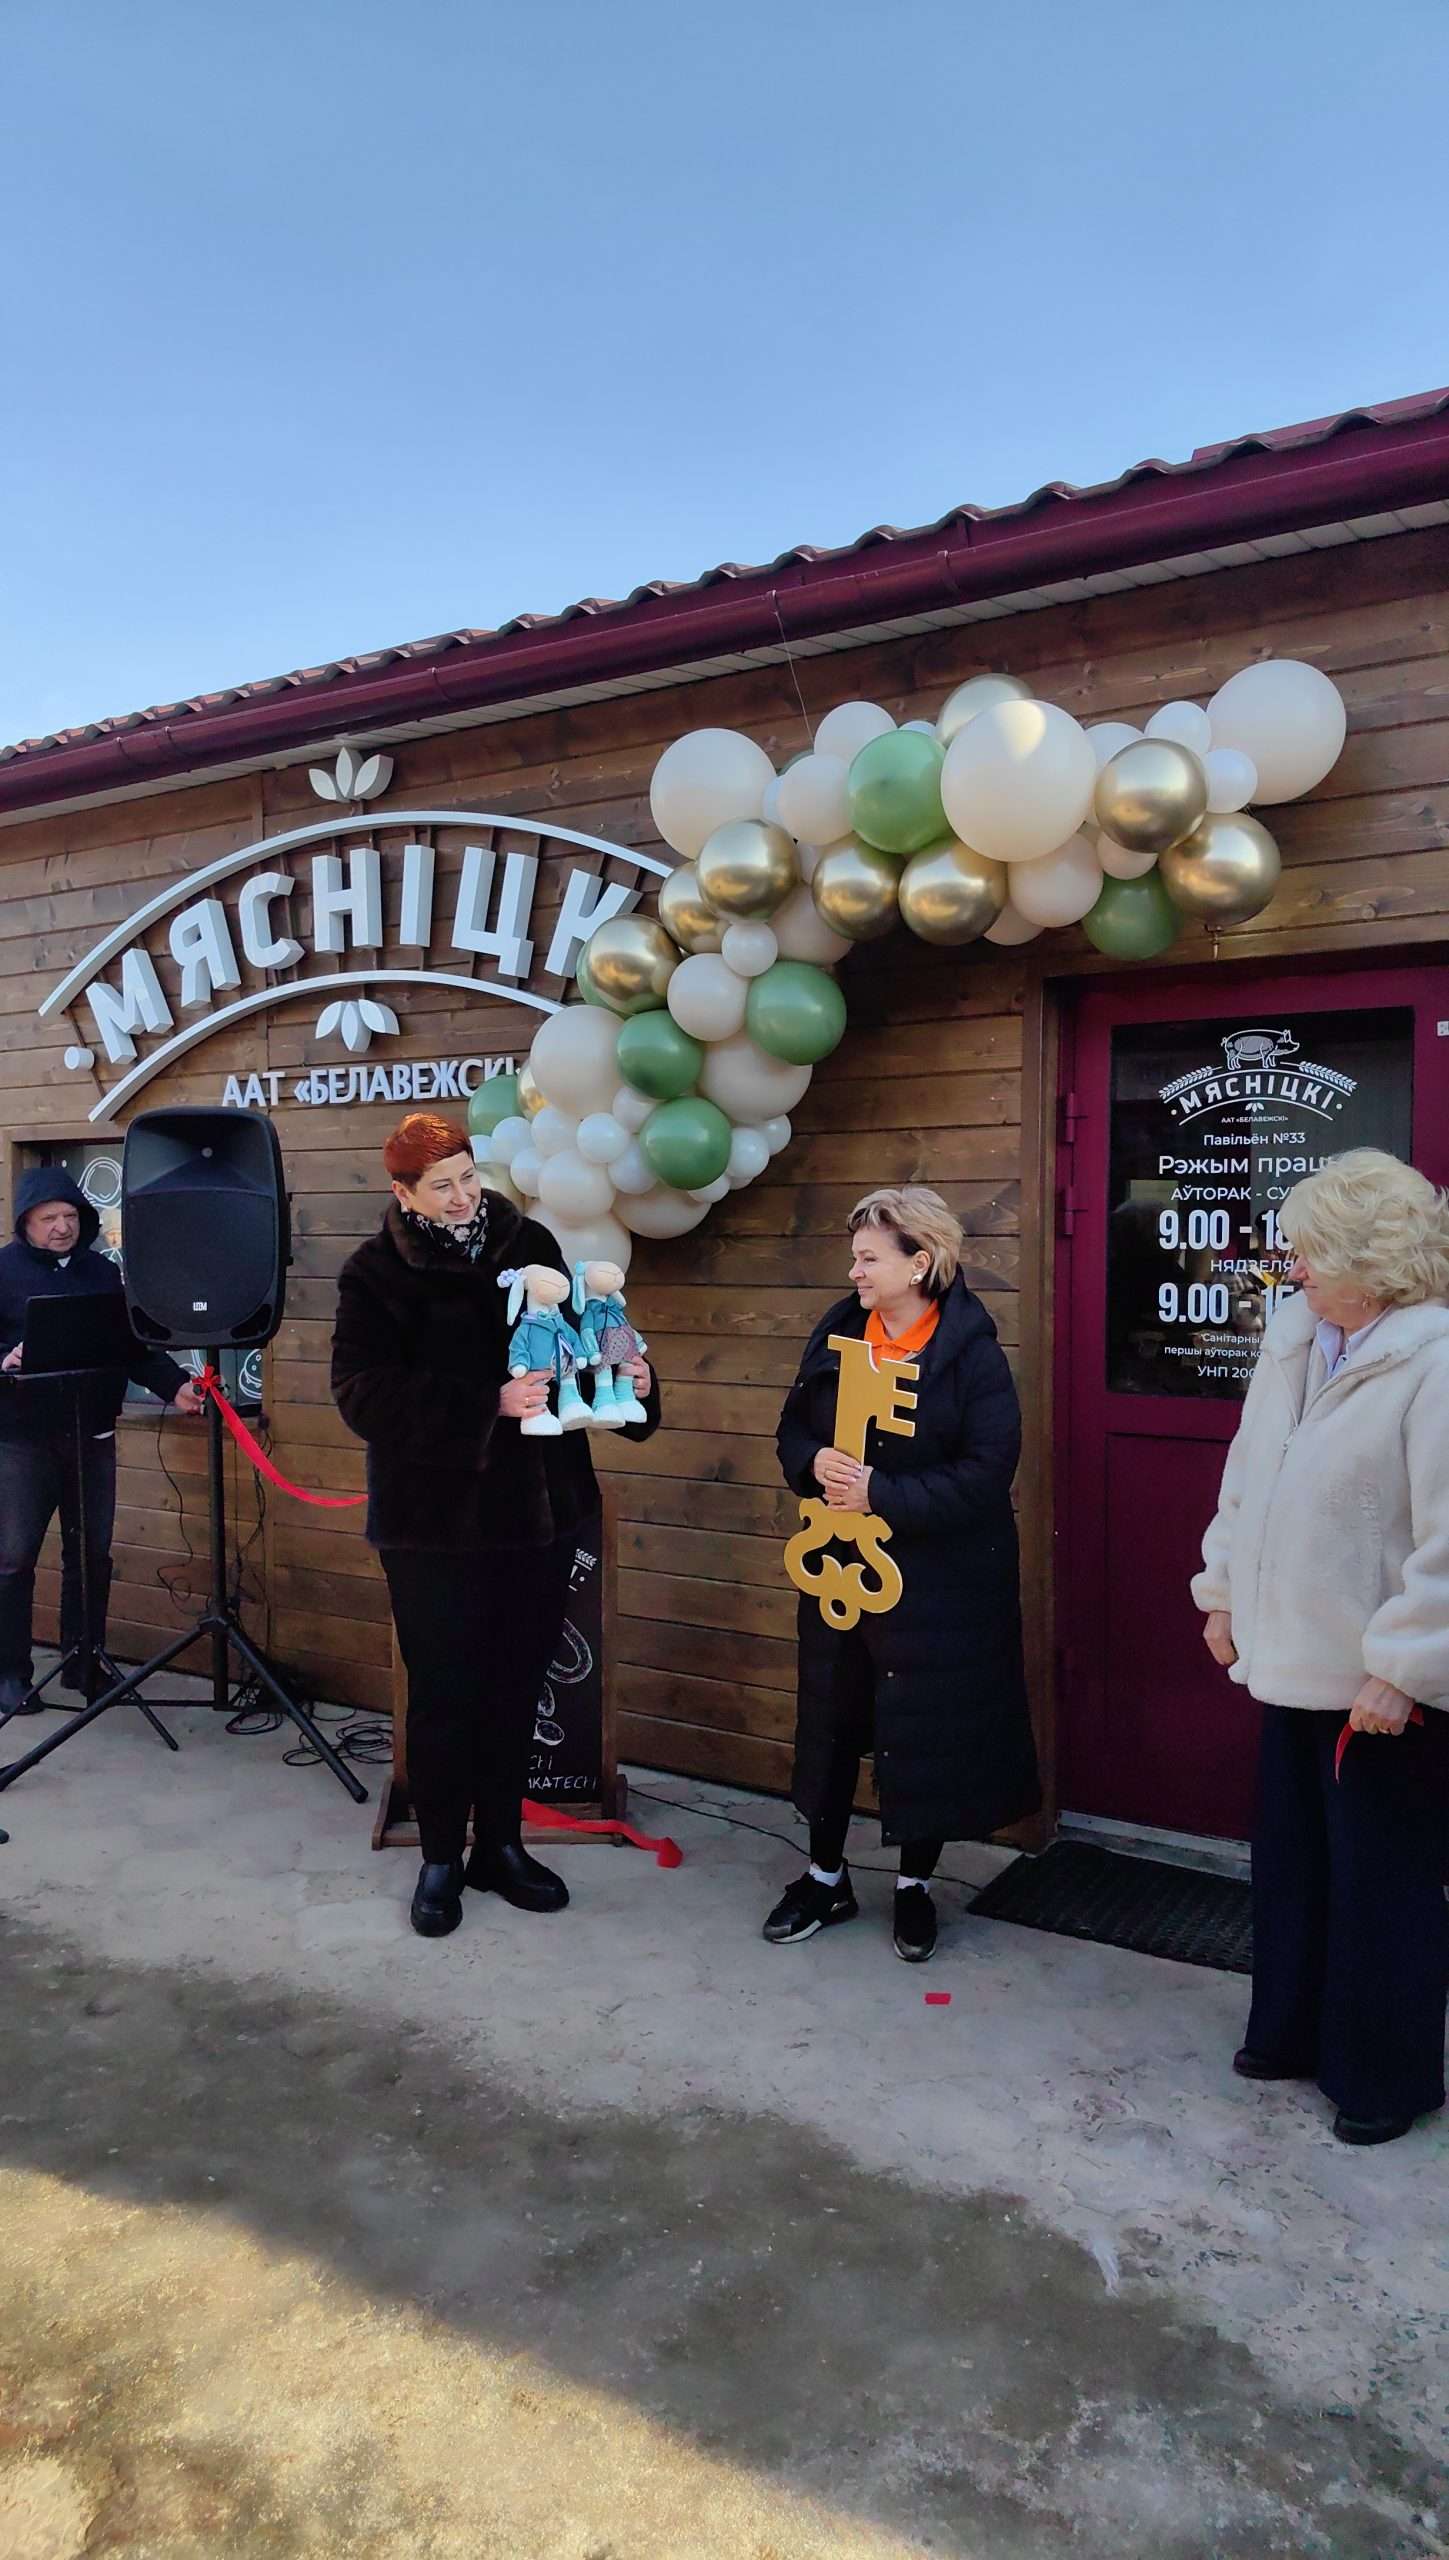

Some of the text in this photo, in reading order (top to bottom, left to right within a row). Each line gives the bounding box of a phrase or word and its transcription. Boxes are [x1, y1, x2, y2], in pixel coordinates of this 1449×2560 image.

[86, 843, 643, 1065] МЯСНІЦК
[222, 1071, 286, 1108] ААТ
[1178, 1074, 1334, 1114] МЯСНІЦКІ
[1203, 1132, 1306, 1146] Павільён №33
[1158, 1155, 1331, 1177] Рэжым прац
[1171, 1185, 1251, 1201] АЎТОРАК
[1266, 1186, 1295, 1200] СУ
[1159, 1209, 1230, 1250] 9.00
[1210, 1259, 1294, 1274] НЯДЗЕЛЯ
[1158, 1282, 1229, 1324] 9.00
[1164, 1346, 1202, 1356] першы
[1205, 1347, 1248, 1359] аўторак
[1197, 1366, 1228, 1378] УНП
